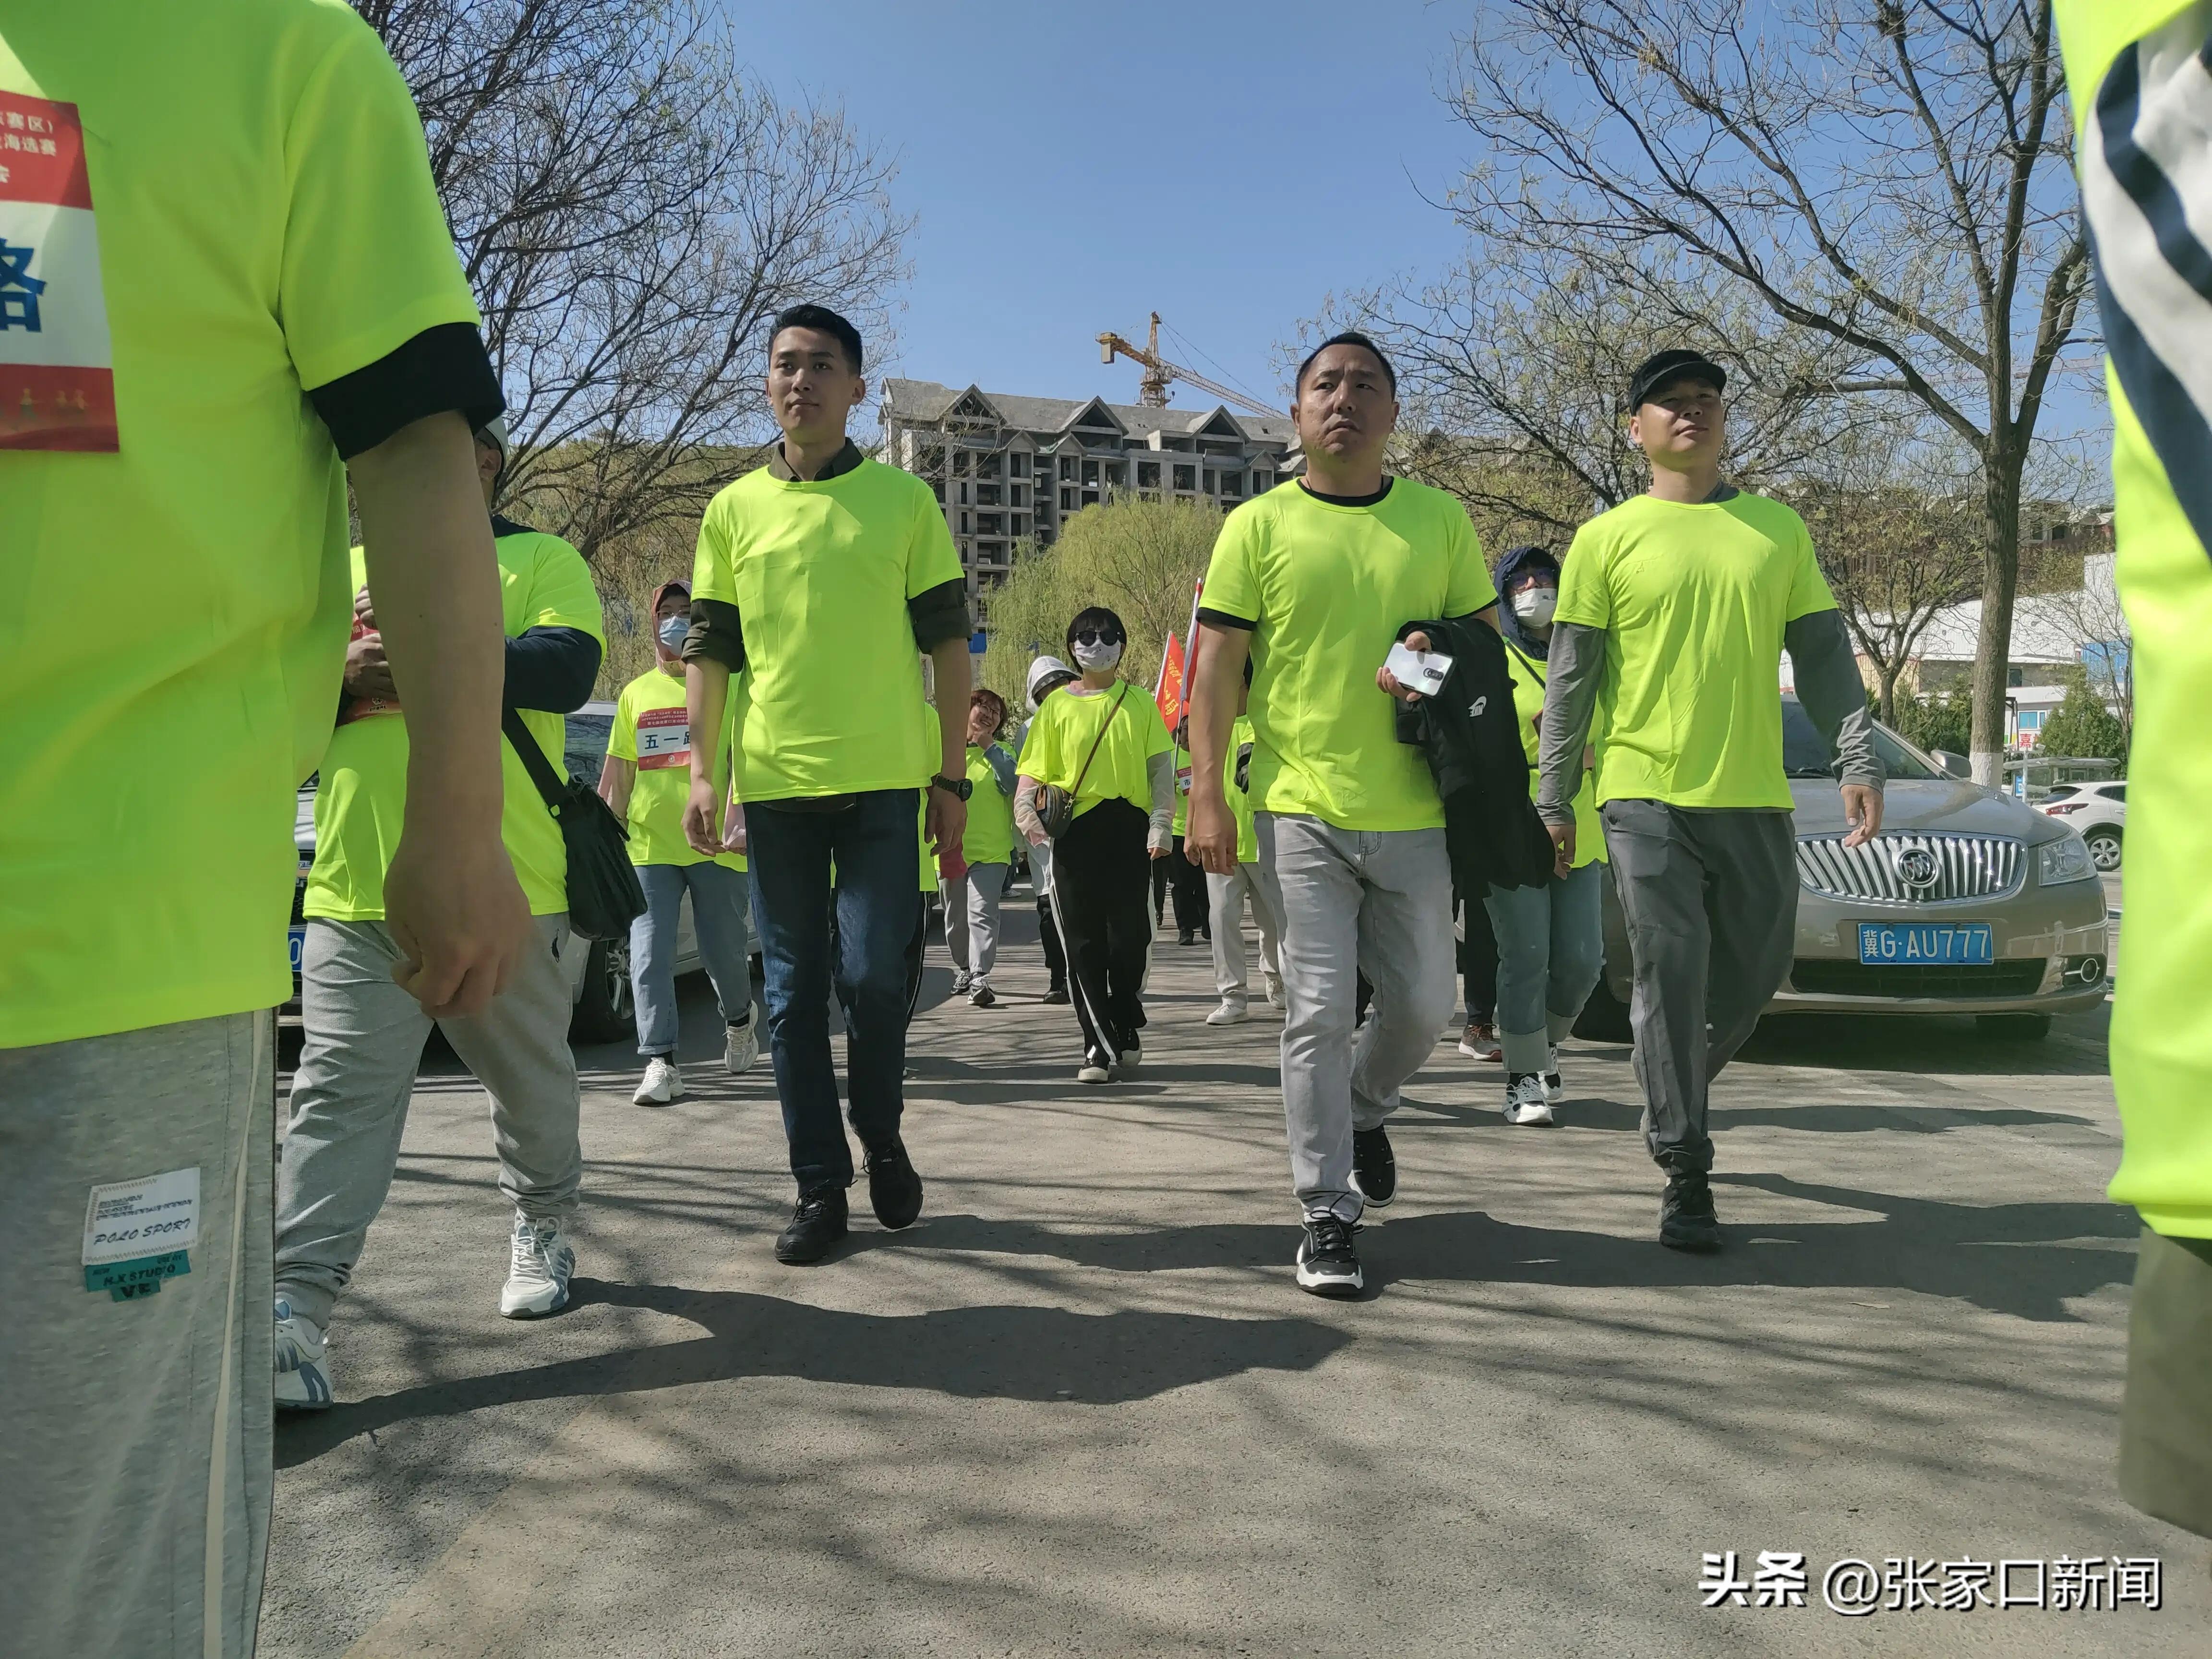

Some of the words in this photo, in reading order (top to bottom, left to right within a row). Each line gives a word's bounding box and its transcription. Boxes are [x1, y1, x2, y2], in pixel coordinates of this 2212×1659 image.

[0, 132, 57, 157] 海选赛
[2020, 733, 2038, 748] 嘉
[1863, 930, 1988, 958] 冀G·AU777
[94, 1229, 139, 1245] POLO
[142, 1217, 191, 1237] SPORT
